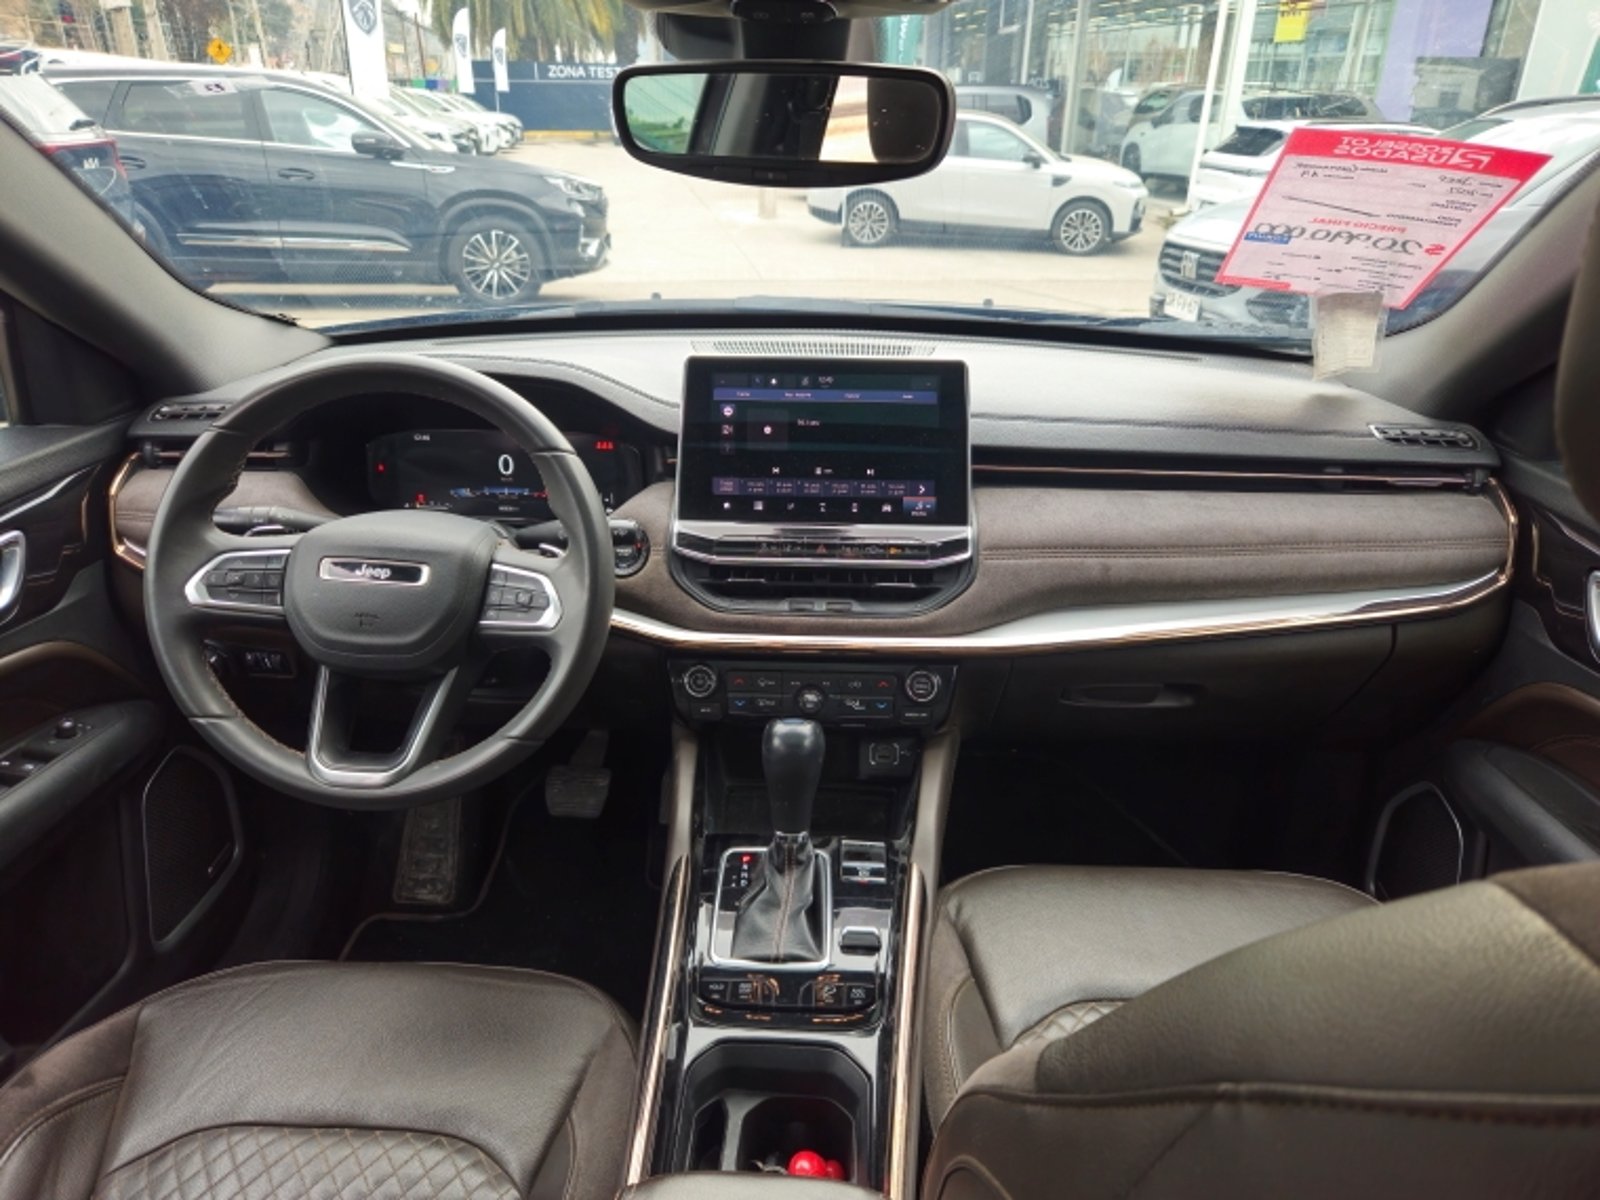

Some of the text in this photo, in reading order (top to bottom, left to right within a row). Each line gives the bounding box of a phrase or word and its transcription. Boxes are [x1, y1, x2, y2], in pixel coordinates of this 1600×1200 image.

[547, 64, 586, 78] ZONA
[498, 453, 515, 475] 0
[355, 563, 393, 580] Jeep
